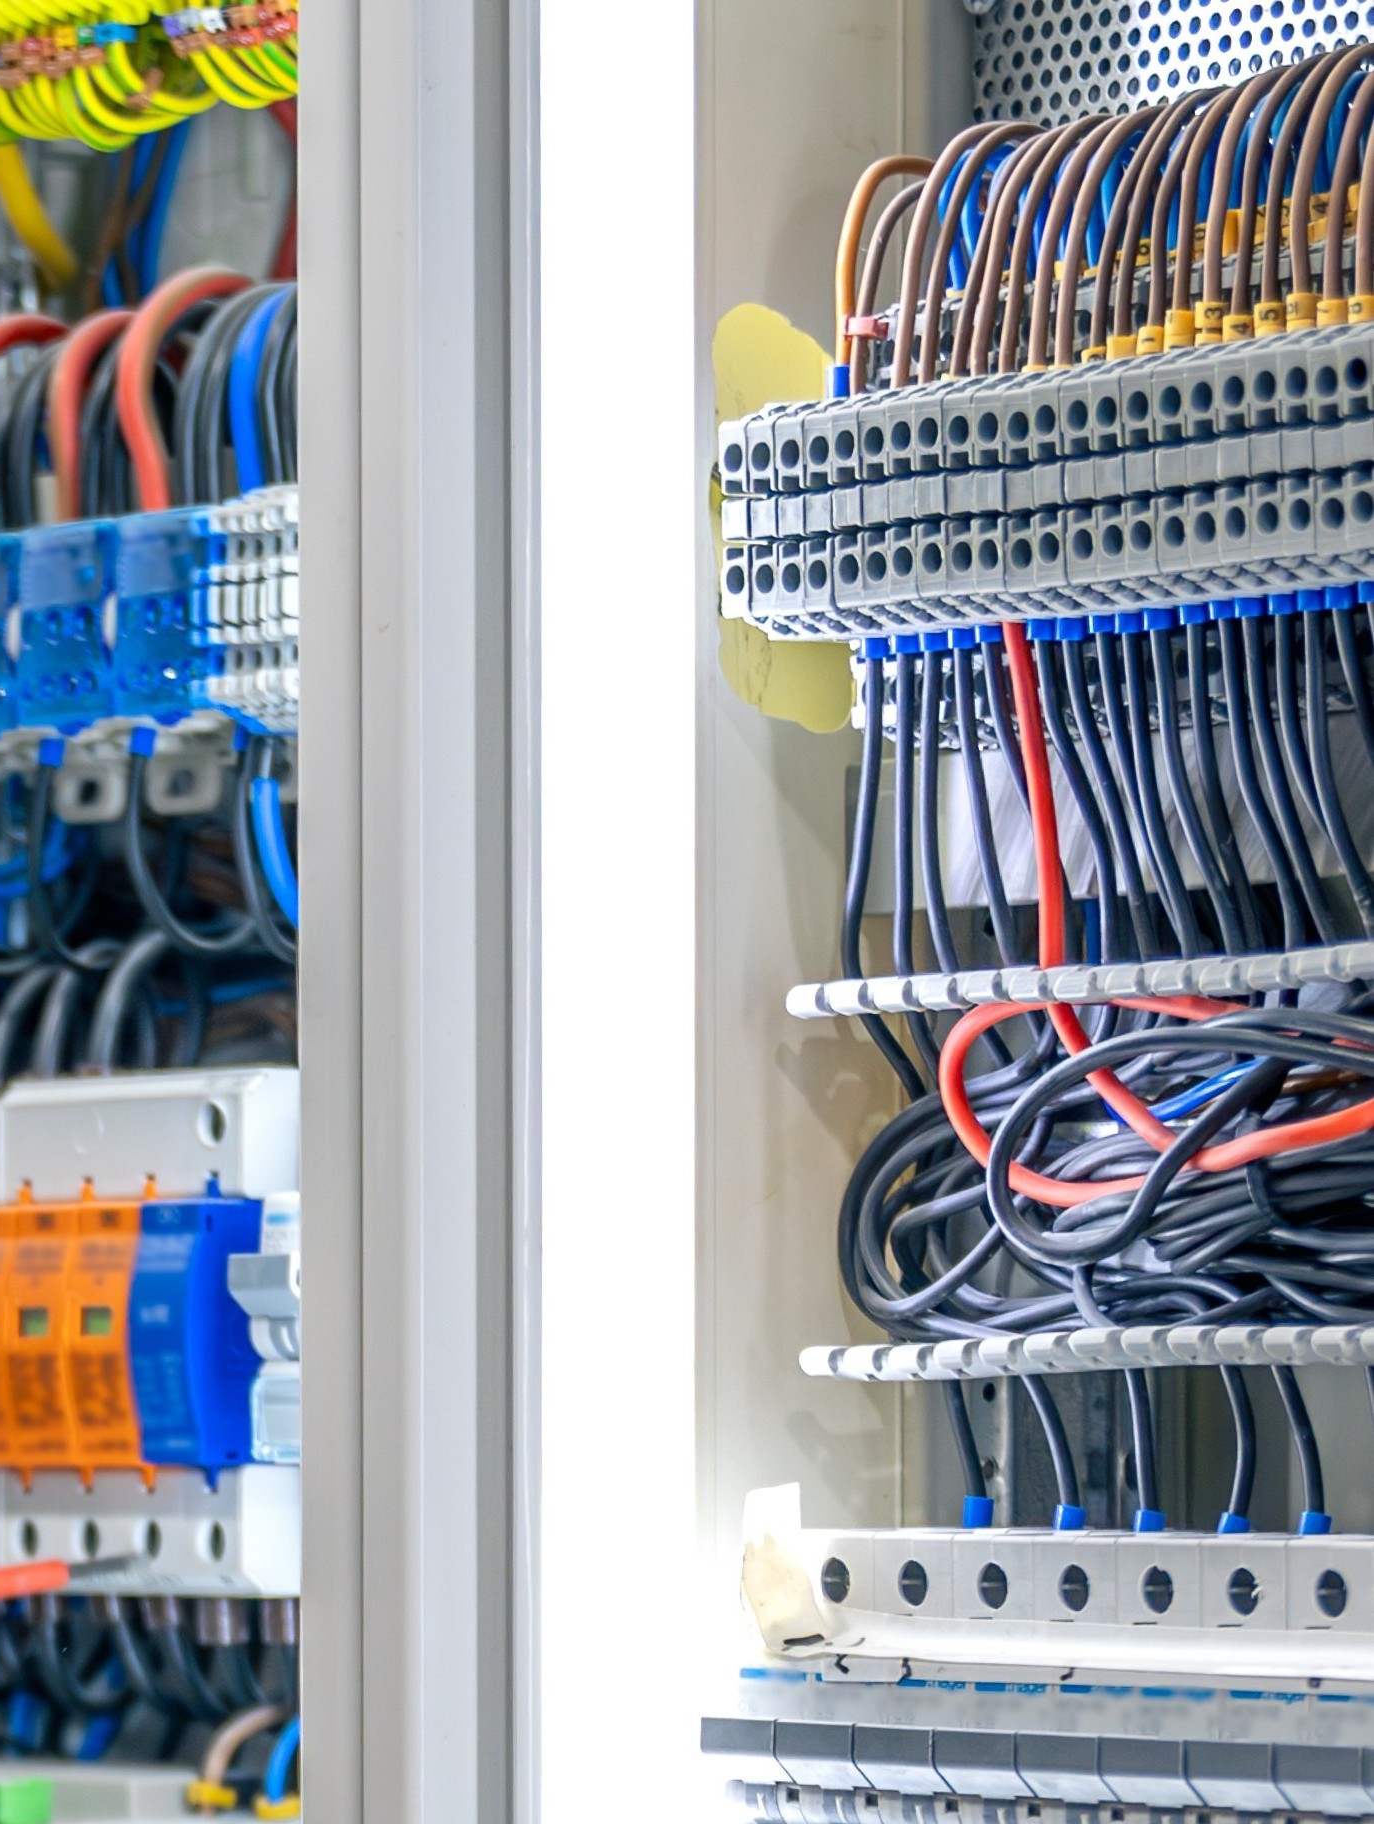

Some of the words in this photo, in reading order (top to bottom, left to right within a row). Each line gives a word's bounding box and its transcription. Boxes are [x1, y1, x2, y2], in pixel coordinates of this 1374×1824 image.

[1204, 307, 1223, 320] 3
[1259, 308, 1279, 321] 5
[1229, 322, 1249, 335] 4
